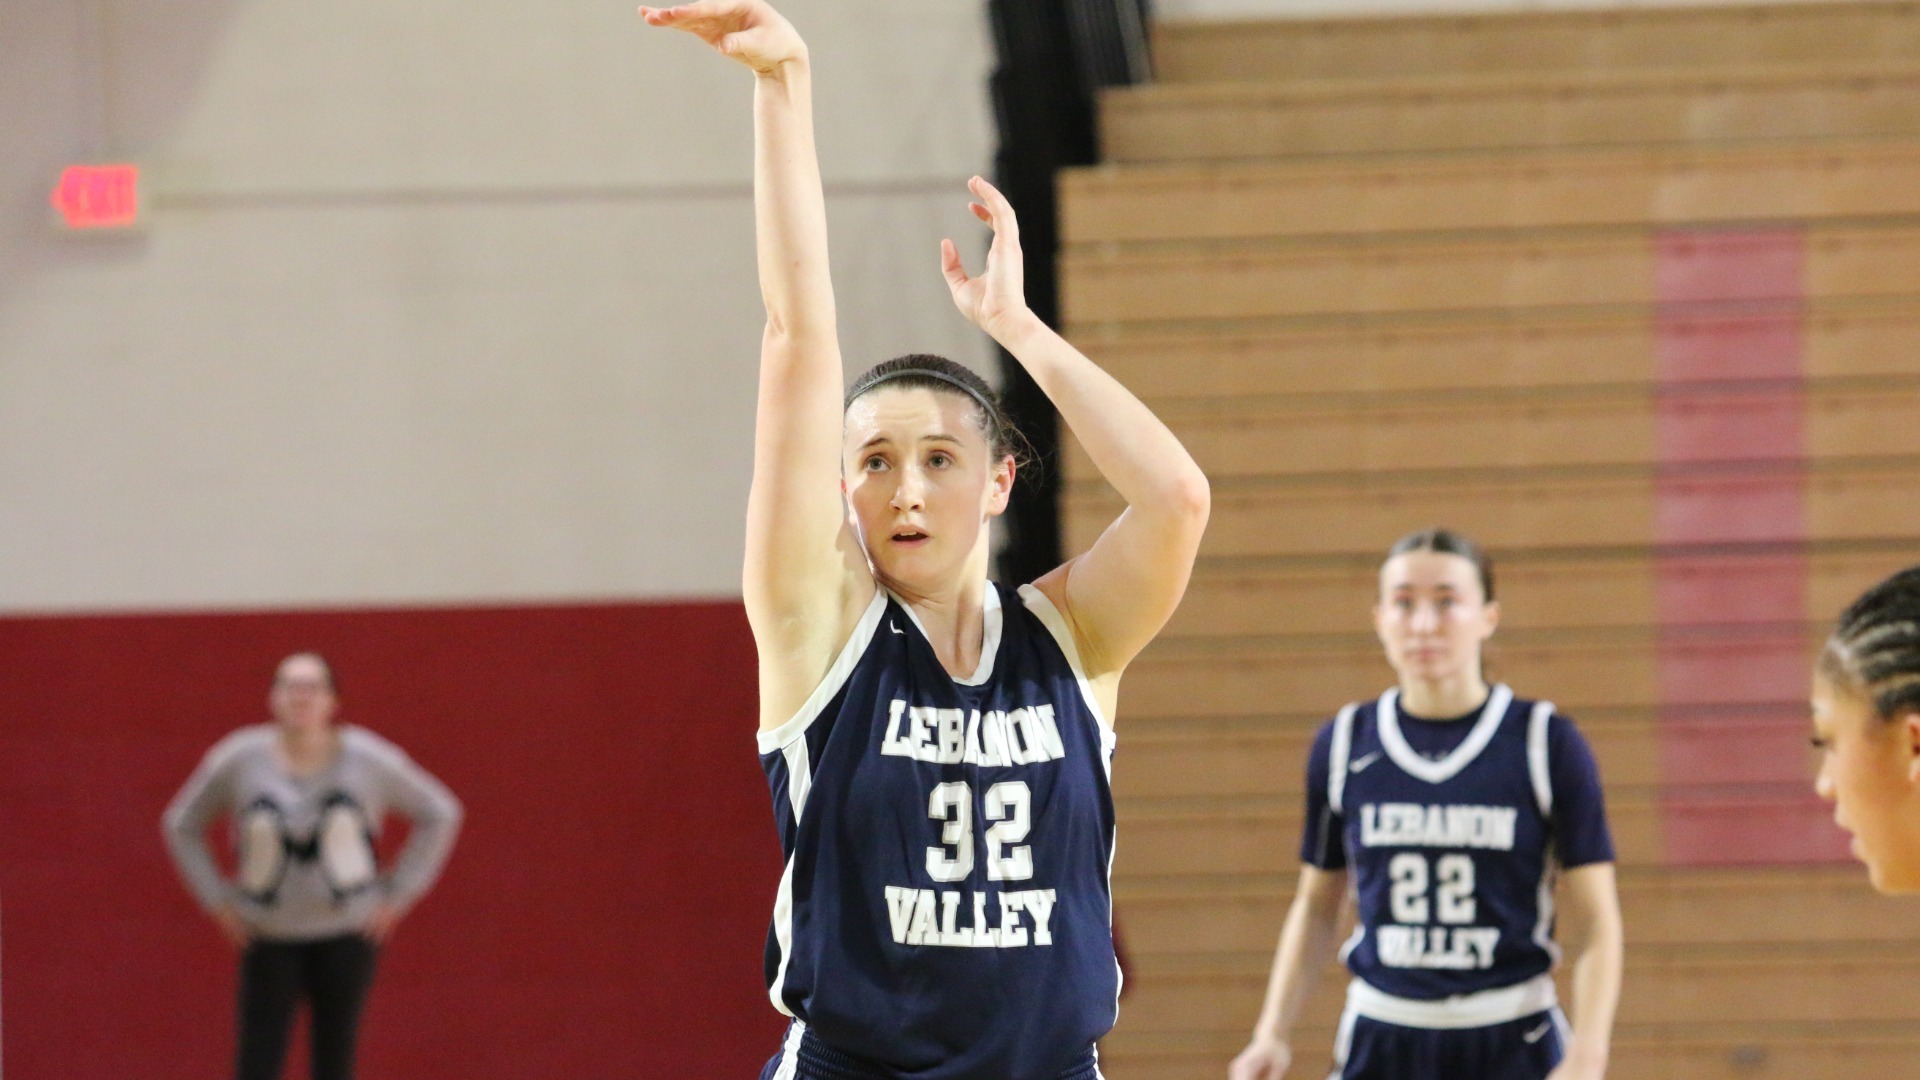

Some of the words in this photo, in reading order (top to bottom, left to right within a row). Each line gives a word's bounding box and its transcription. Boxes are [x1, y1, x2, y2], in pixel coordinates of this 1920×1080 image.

[881, 699, 1065, 767] LEBANON
[926, 781, 1033, 882] 32
[885, 886, 1056, 947] VALLEY
[1389, 853, 1476, 924] 22
